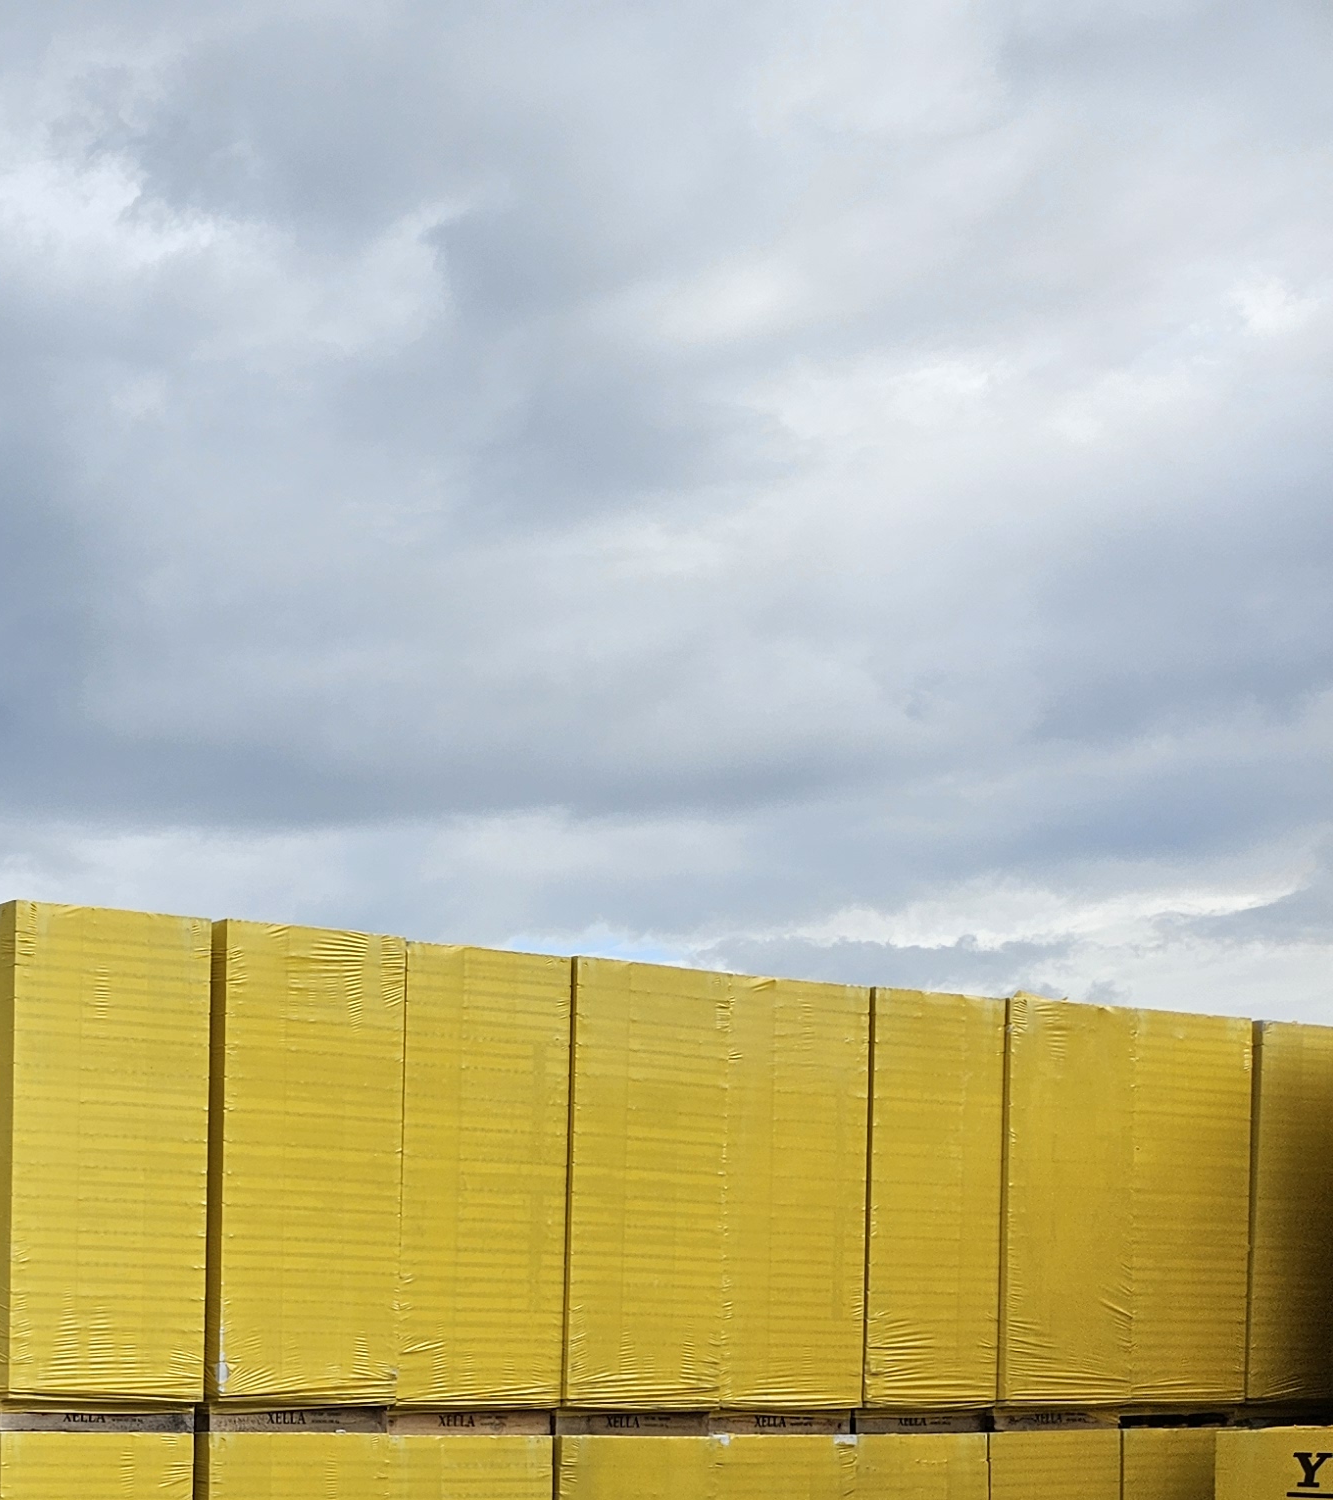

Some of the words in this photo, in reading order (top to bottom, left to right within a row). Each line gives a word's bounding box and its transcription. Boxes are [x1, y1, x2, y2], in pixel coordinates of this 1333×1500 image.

[267, 1411, 306, 1425] XELLA
[438, 1415, 475, 1428] XELLA
[605, 1415, 640, 1429] XELLA
[754, 1415, 787, 1428] XELLA
